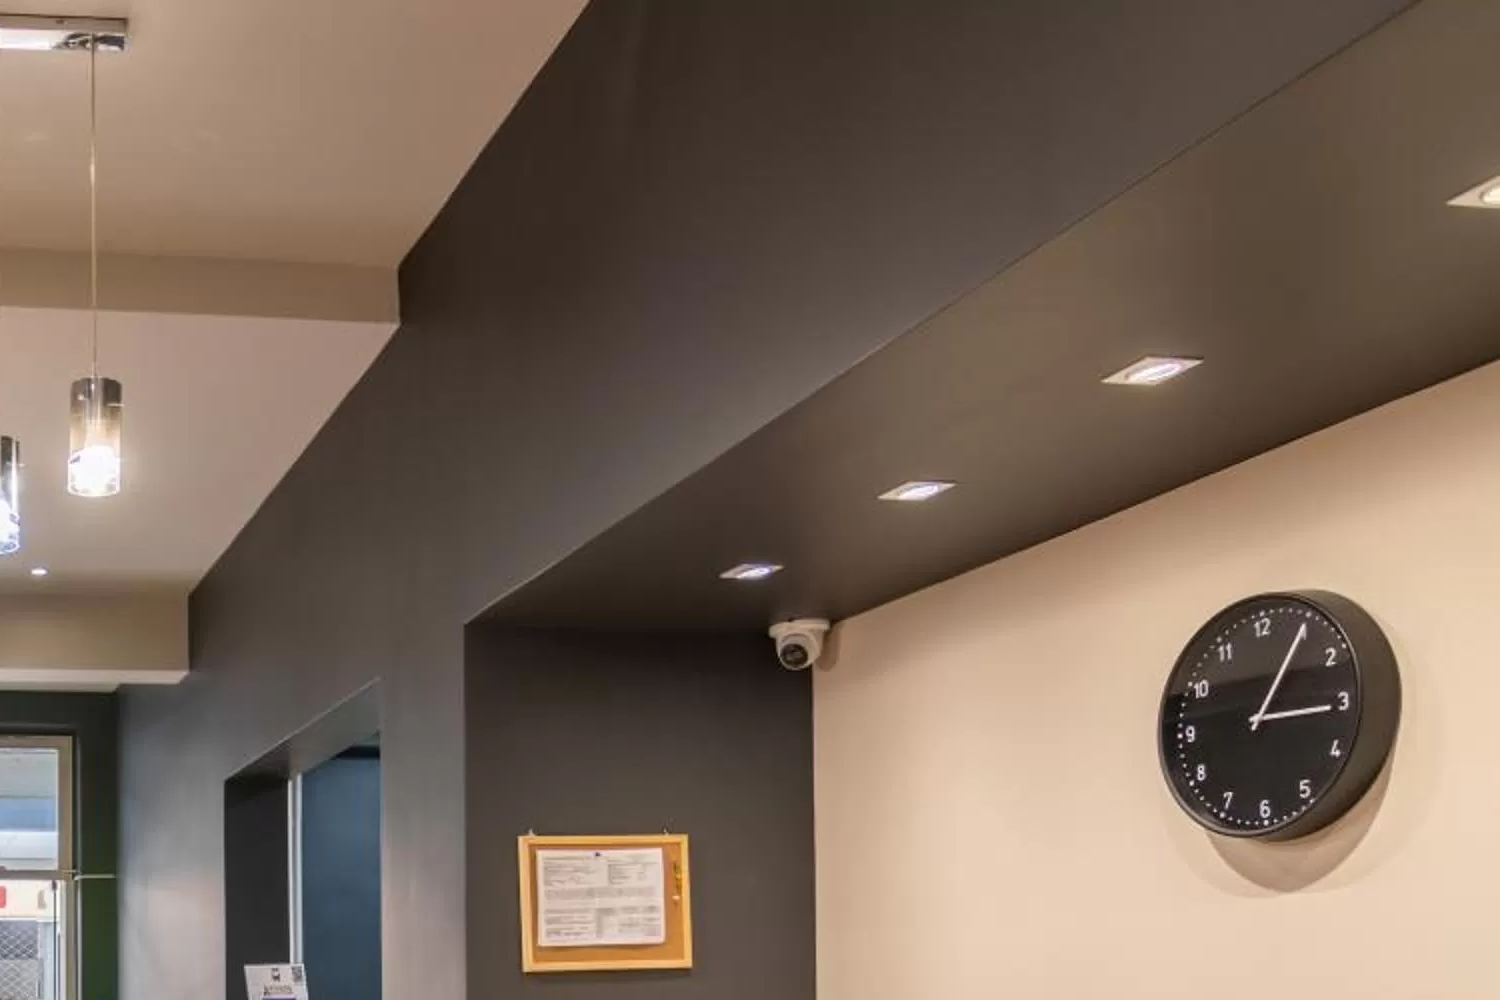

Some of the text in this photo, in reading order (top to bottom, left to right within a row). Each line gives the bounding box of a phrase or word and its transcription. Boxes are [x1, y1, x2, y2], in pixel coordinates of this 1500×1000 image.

[1253, 618, 1271, 637] 12
[1217, 643, 1232, 662] 11
[1325, 648, 1337, 667] 2
[1193, 680, 1209, 699] 10
[1337, 692, 1349, 711] 3
[1185, 726, 1196, 742] 9
[1330, 739, 1341, 757] 4
[1196, 764, 1206, 781] 8
[1299, 779, 1311, 798] 5
[1223, 791, 1234, 809] 7
[1259, 800, 1270, 818] 6
